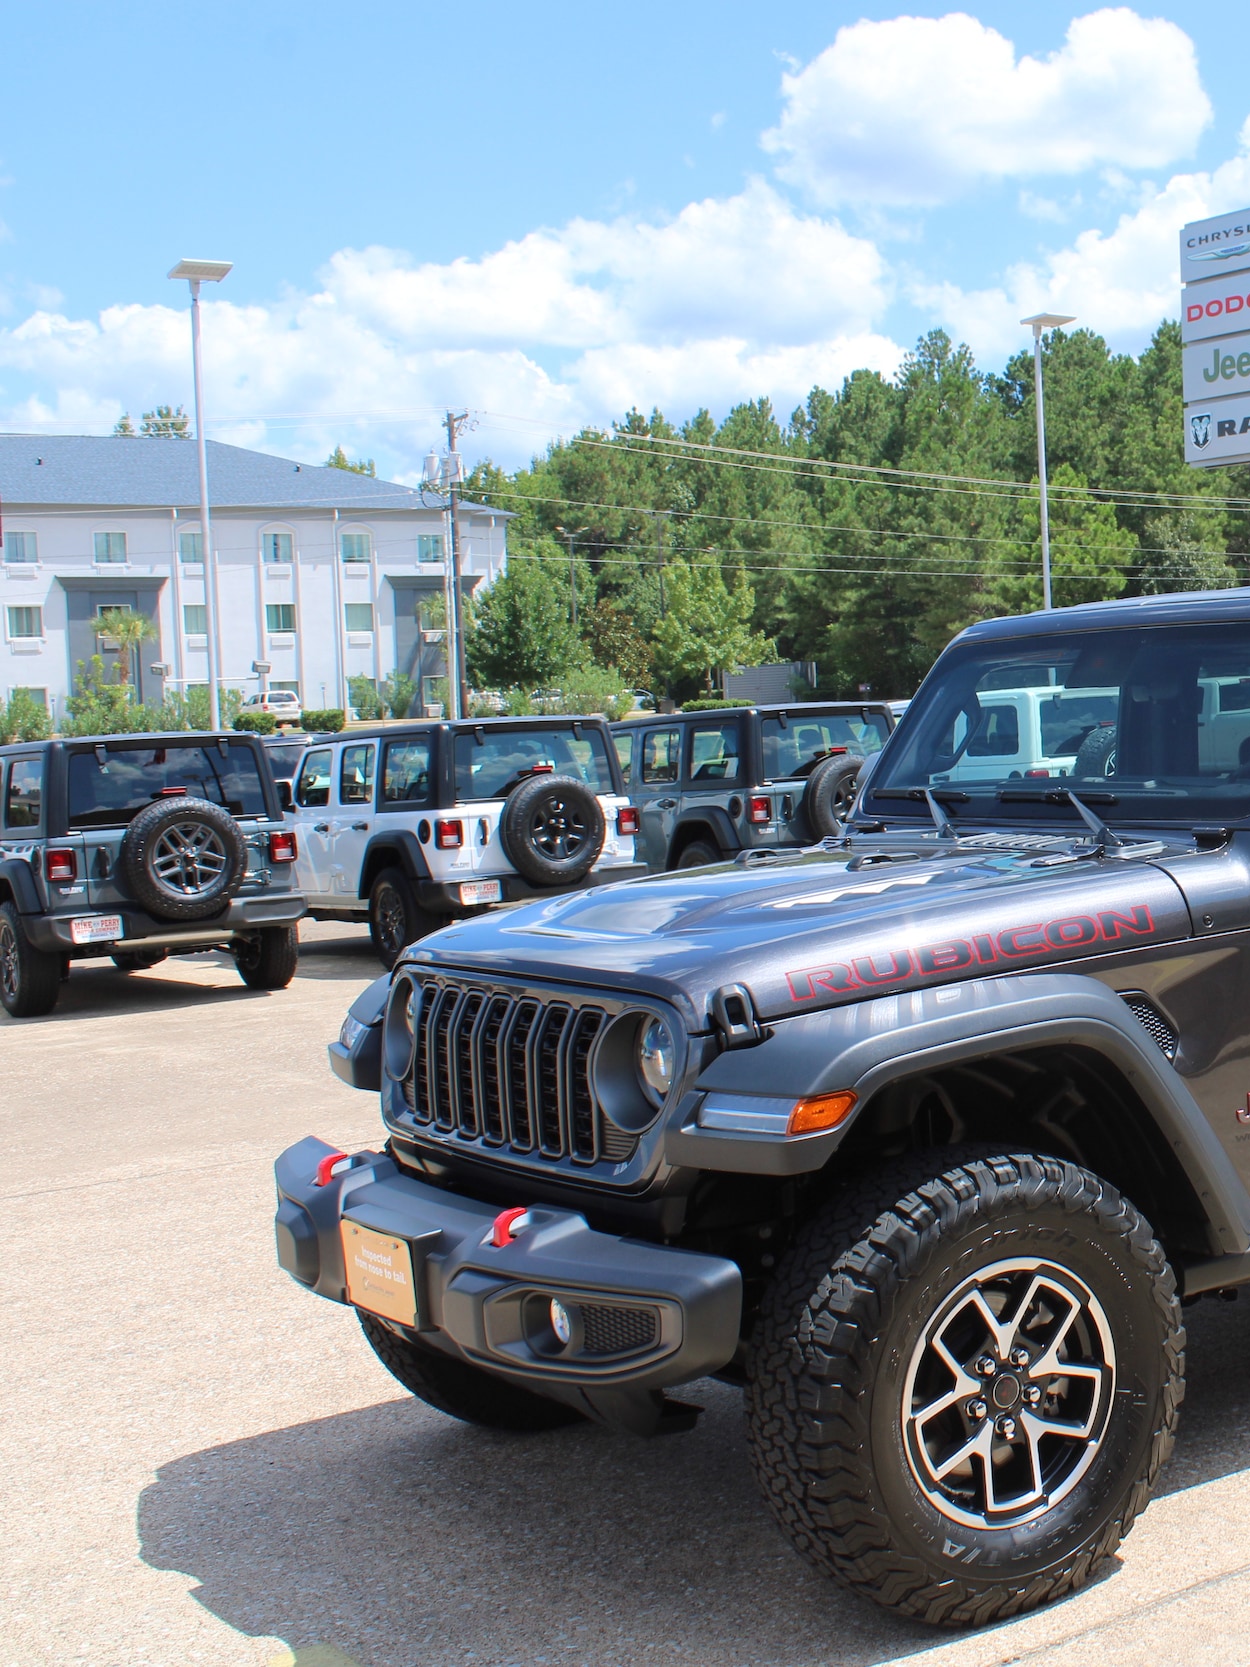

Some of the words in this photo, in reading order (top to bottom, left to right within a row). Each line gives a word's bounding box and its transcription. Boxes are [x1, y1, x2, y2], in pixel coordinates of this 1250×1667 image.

[785, 904, 1155, 1002] RUBICON
[361, 1245, 392, 1267] Inspected
[368, 1264, 383, 1277] nose
[384, 1268, 392, 1280] to
